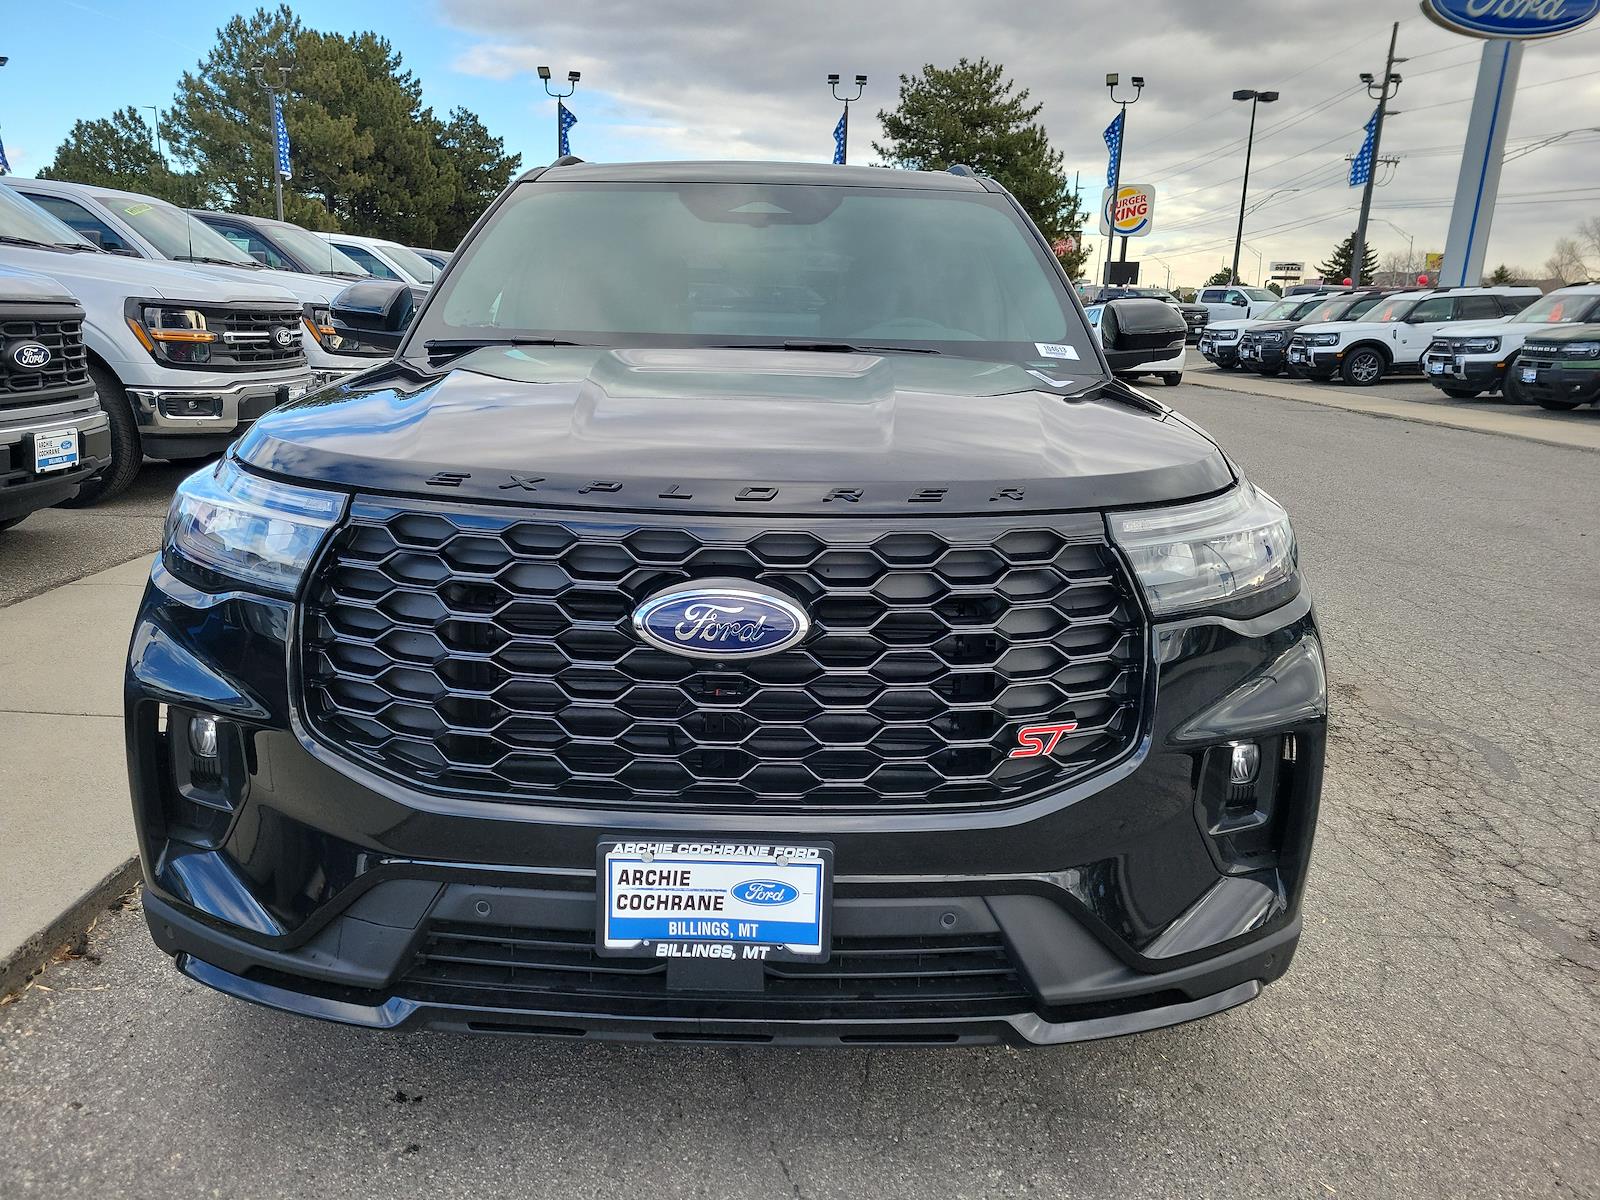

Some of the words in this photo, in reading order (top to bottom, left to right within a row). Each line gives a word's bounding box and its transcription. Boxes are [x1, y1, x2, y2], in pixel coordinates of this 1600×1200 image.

[22, 347, 45, 364] Ford
[425, 471, 1025, 502] EXPLORER
[674, 603, 767, 642] Ford
[1009, 722, 1078, 758] ST
[611, 843, 674, 854] ARCHIE
[677, 844, 770, 857] COCHRANE
[773, 847, 819, 859] FORD
[617, 869, 691, 887] ARCHIE
[744, 883, 785, 902] Ford
[616, 894, 725, 912] COCHRANE
[668, 921, 734, 939] BILLINGS,
[738, 923, 759, 938] MT
[655, 943, 737, 960] BILLINGS,
[742, 945, 770, 960] MT
